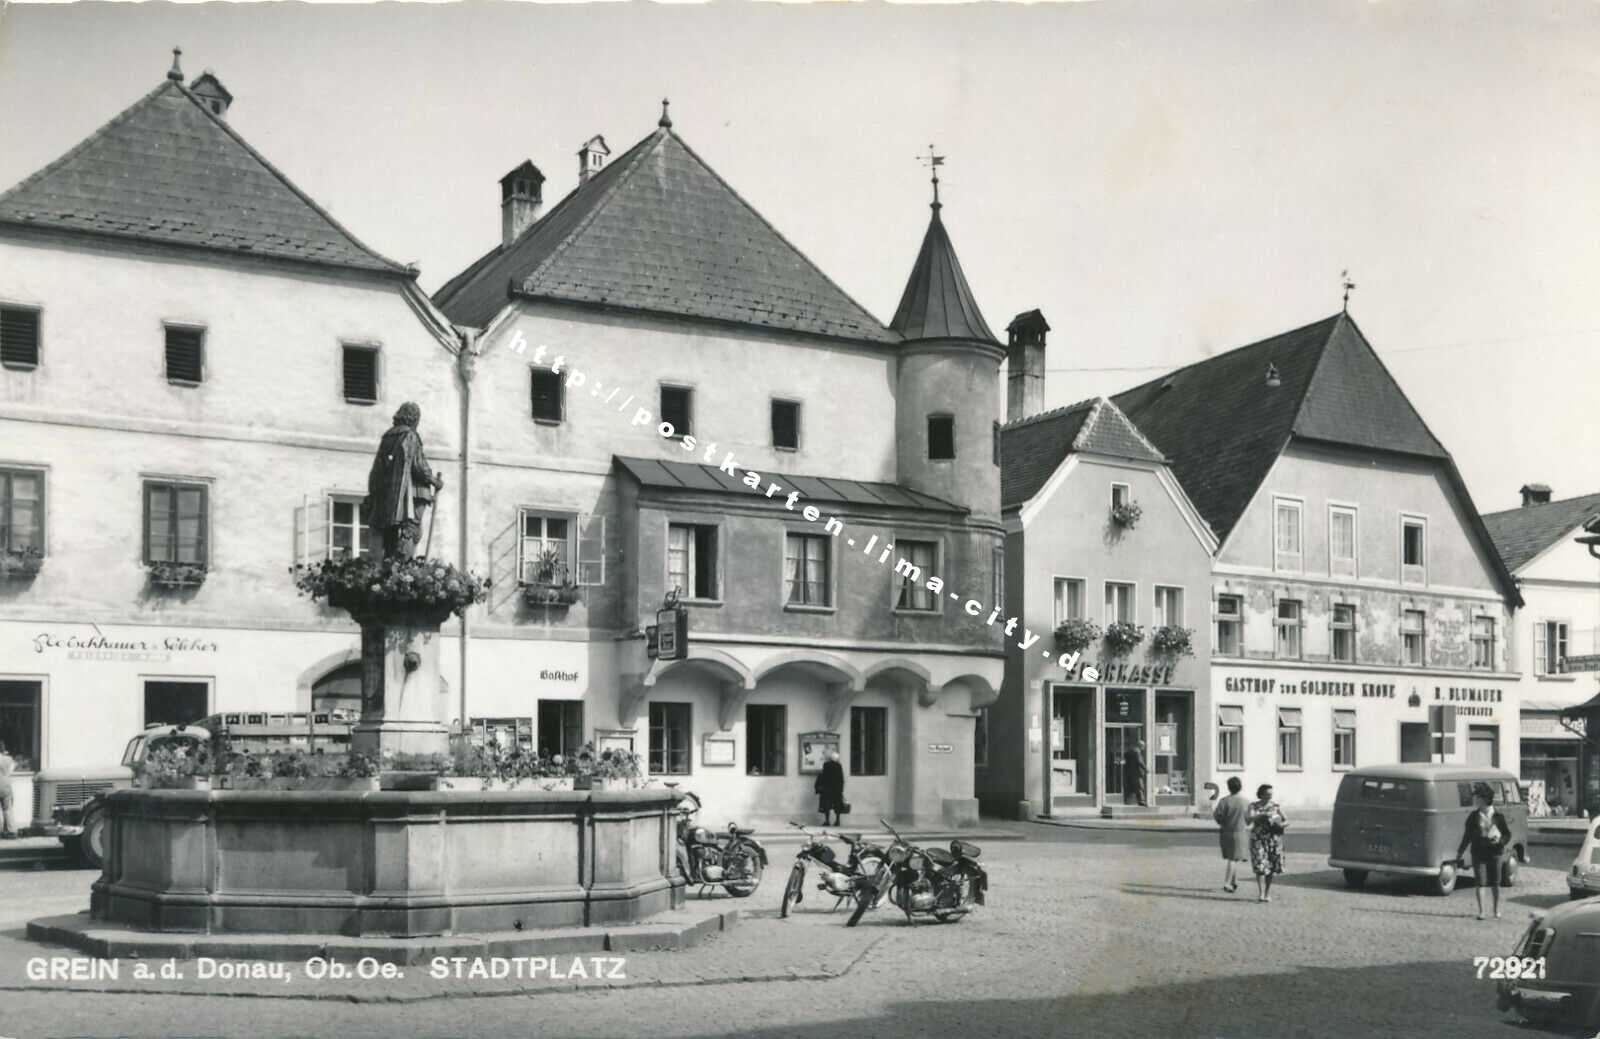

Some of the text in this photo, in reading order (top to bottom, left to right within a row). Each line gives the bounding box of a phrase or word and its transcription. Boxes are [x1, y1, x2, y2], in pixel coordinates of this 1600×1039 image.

[1225, 676, 1276, 694] GASTHOF
[1361, 682, 1397, 699] KRONE
[1449, 687, 1503, 703] BLUMAUER
